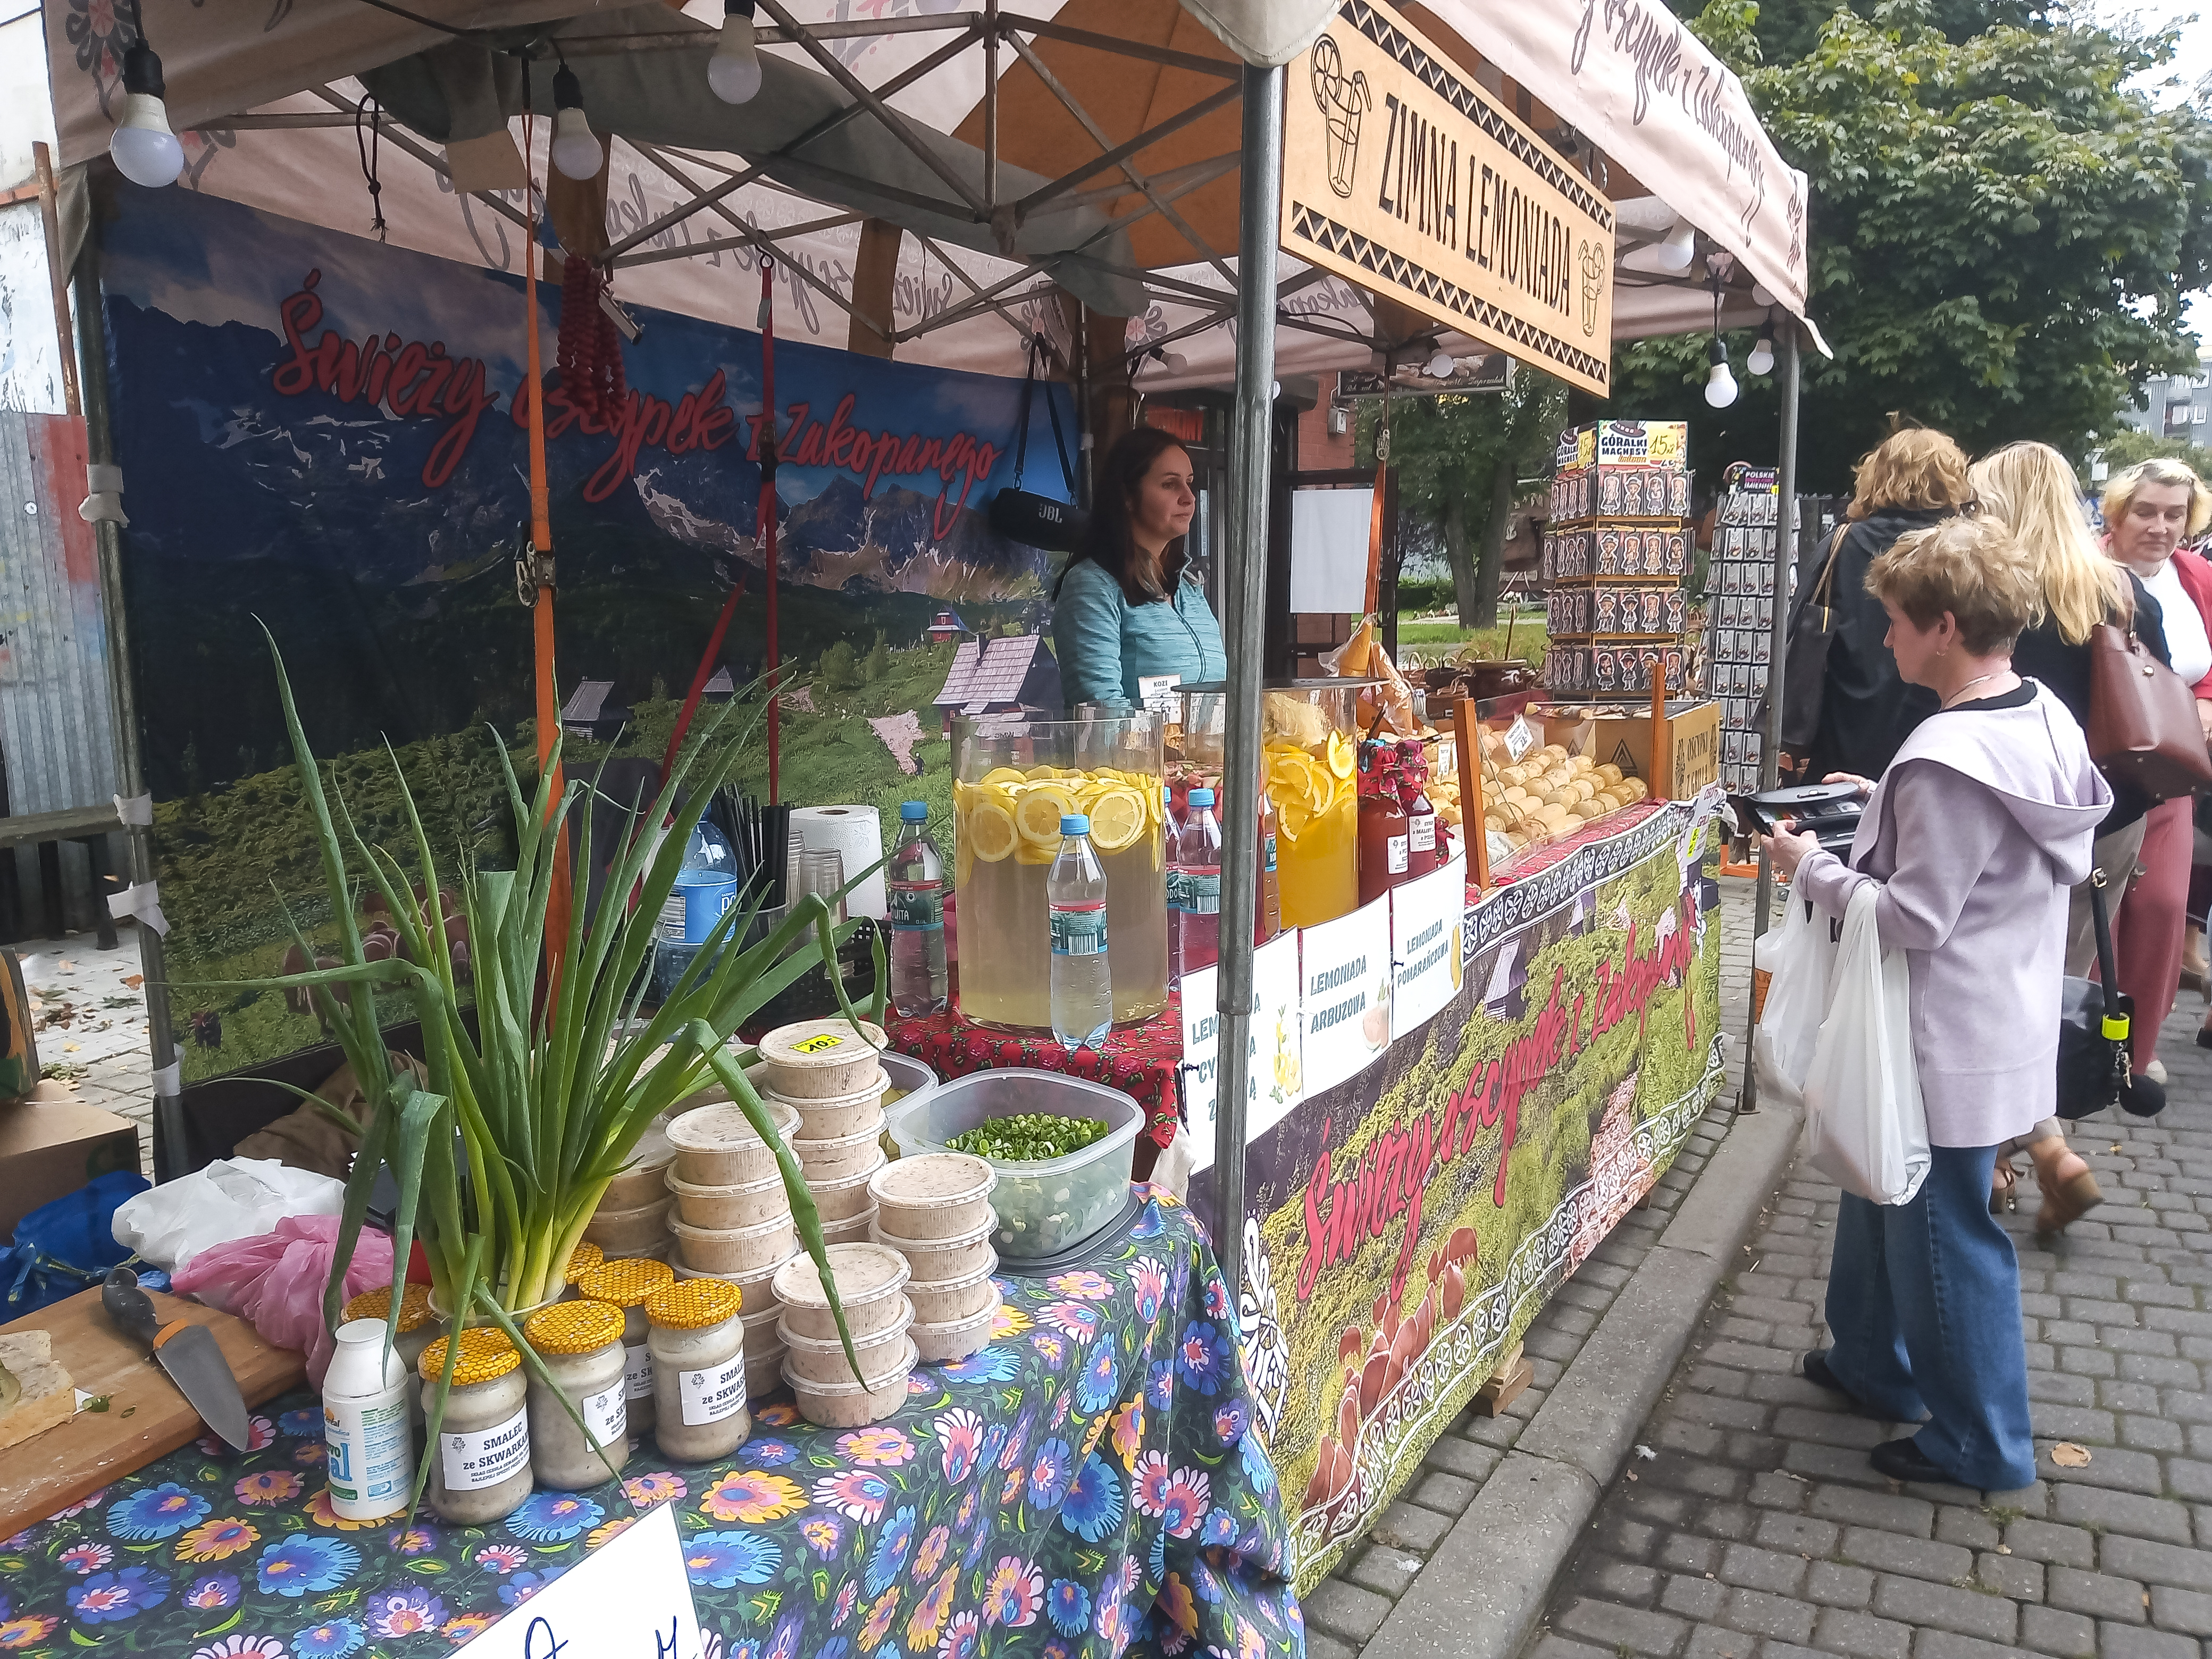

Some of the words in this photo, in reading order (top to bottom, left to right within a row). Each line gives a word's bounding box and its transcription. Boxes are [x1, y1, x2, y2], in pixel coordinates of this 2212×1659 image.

[1378, 91, 1456, 252] ZIMNA
[1466, 154, 1570, 317] LEMONIADA
[273, 267, 500, 488] Świeży
[1601, 433, 1647, 447] GÓRALKI
[1038, 504, 1062, 524] JBL
[1687, 731, 1708, 762] OSCYPKI
[1687, 773, 1690, 799] Z
[1691, 764, 1707, 795] GRILLA
[1407, 918, 1443, 954] LEMONIADA
[1310, 954, 1367, 996] LEMONIADA
[1397, 939, 1449, 989] POMARAŃCZOWA
[1310, 991, 1366, 1034] ARBUZOWA
[1297, 1110, 1431, 1303] Świeży
[1439, 963, 1568, 1208] oscypek
[702, 1396, 713, 1405] ze
[483, 1421, 523, 1451] SMALEC
[605, 1415, 614, 1426] ze
[463, 1462, 475, 1470] ze
